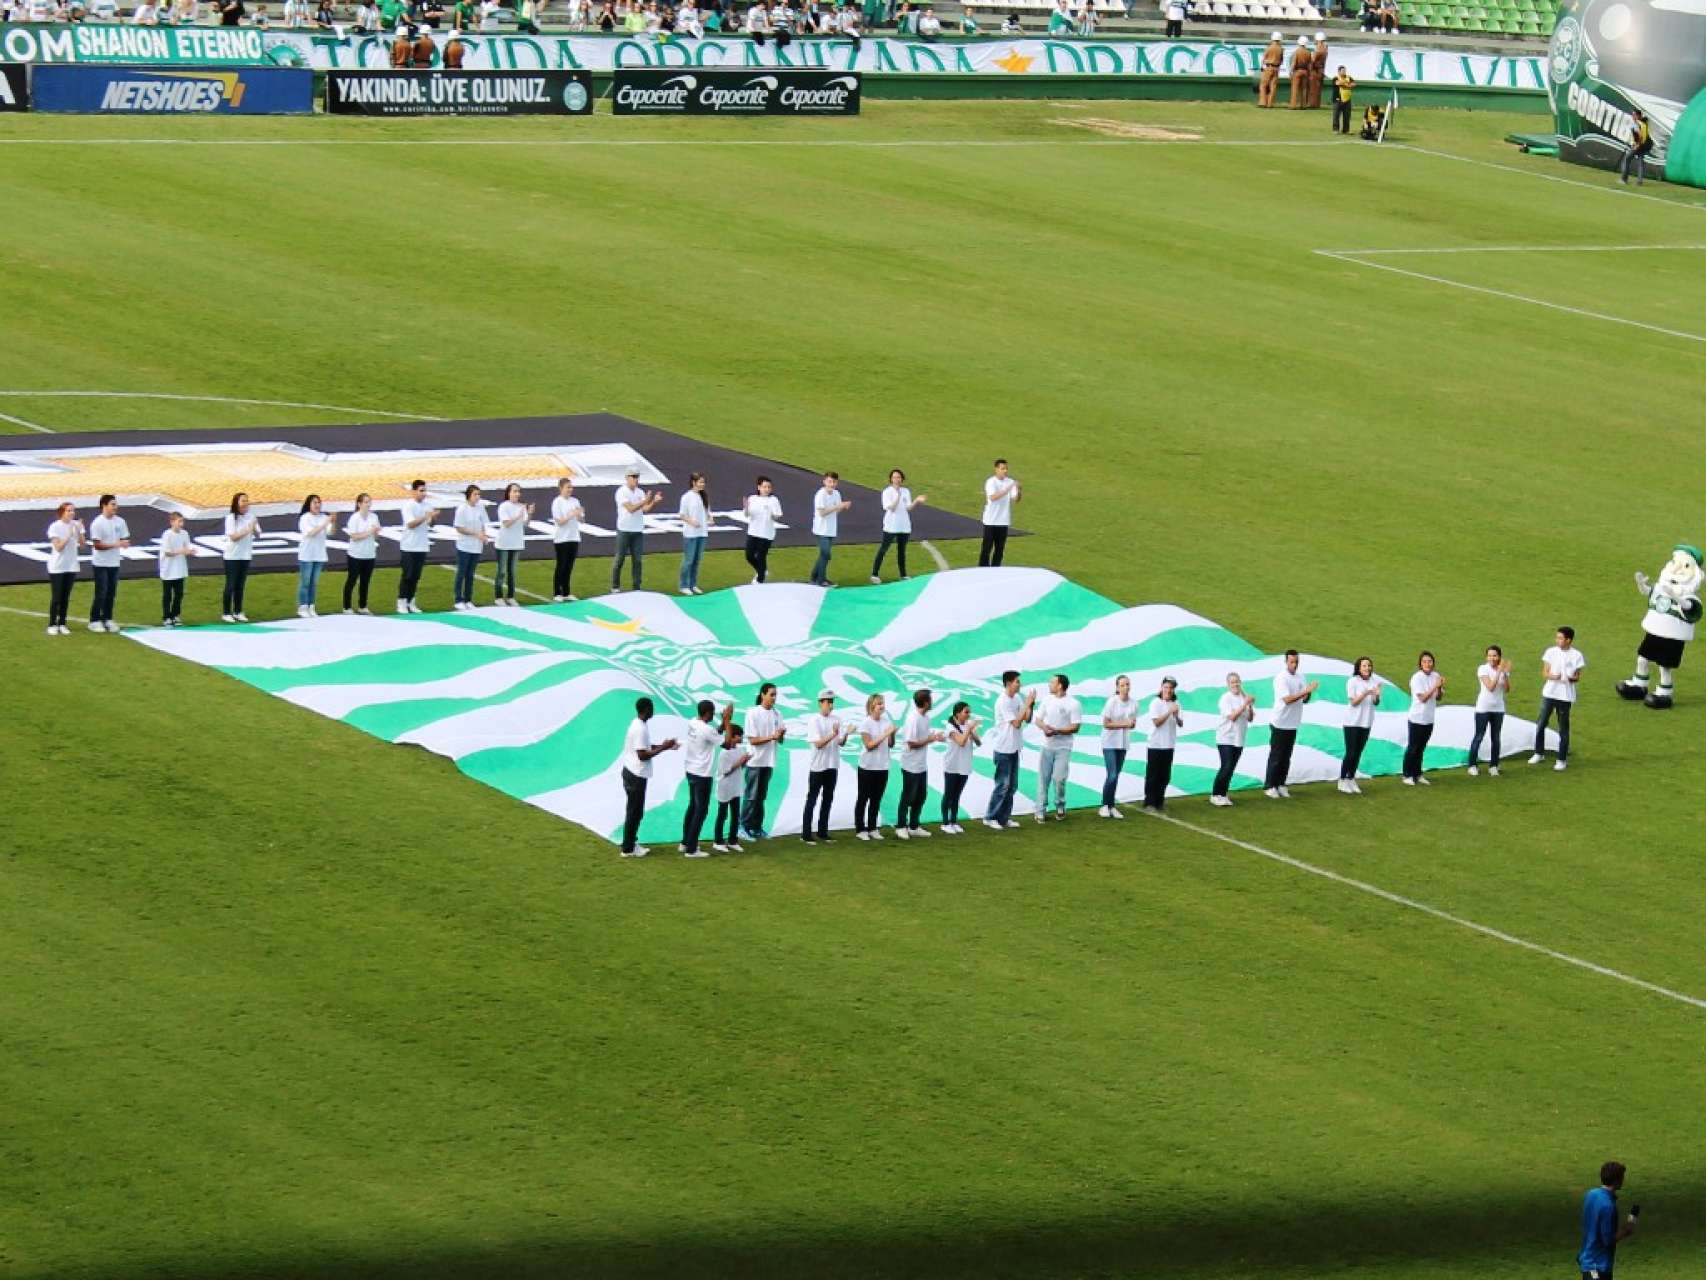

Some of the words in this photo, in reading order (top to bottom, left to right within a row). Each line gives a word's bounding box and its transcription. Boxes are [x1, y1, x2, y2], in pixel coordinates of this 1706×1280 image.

[0, 29, 76, 62] OM
[77, 27, 169, 58] SHANON
[174, 29, 262, 59] ETERNO
[101, 80, 224, 111] NETSHOES
[336, 77, 427, 102] YAKINDA:
[431, 73, 468, 103] ÜYE
[472, 78, 551, 102] OLUNUZ.
[617, 85, 689, 110] Expoente
[700, 86, 769, 111] Expoente
[780, 86, 849, 111] Expoente
